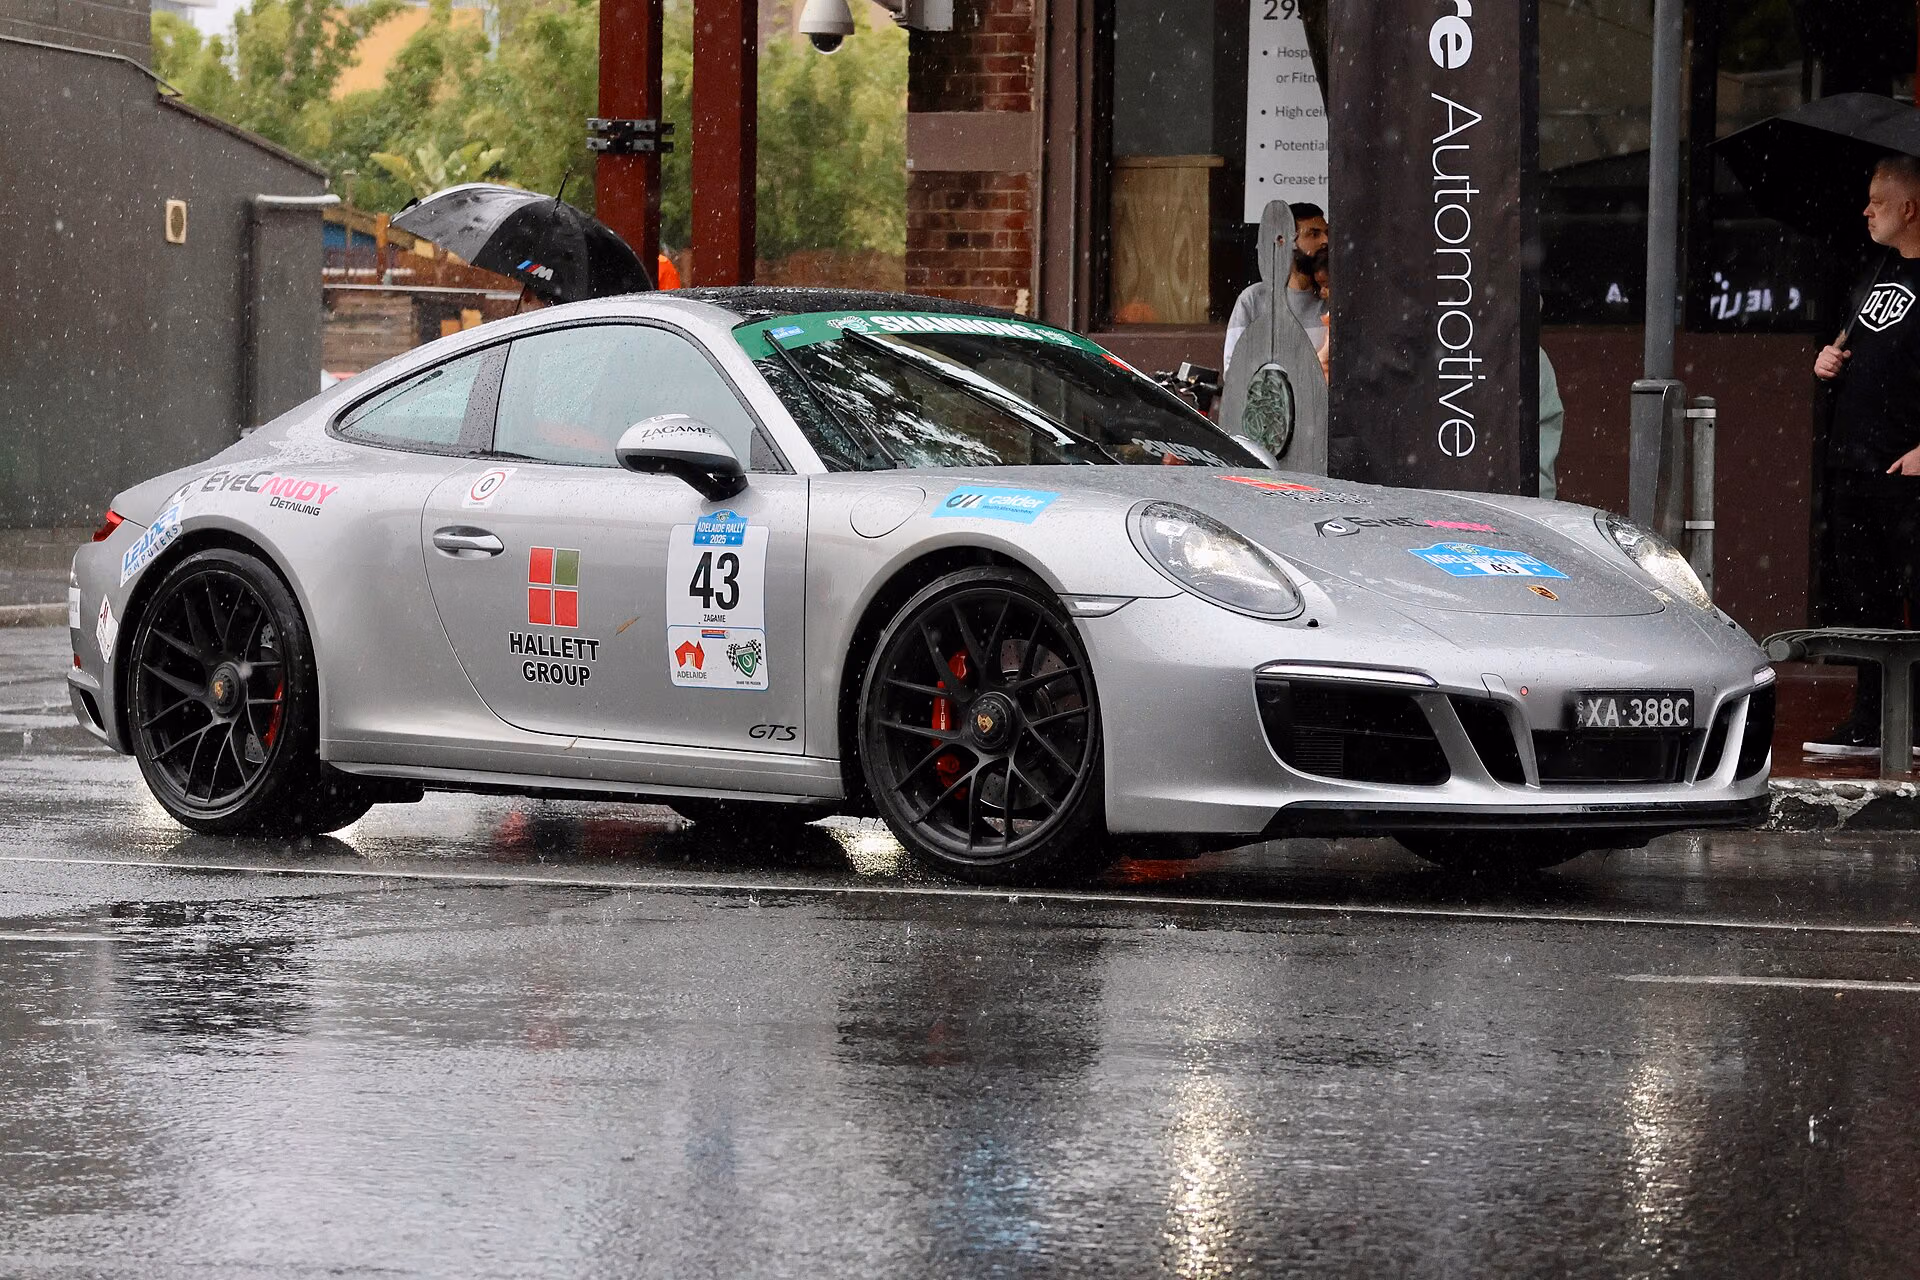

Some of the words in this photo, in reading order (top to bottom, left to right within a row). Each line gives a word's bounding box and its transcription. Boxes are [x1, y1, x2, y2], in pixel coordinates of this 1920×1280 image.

[1263, 0, 1302, 20] 29
[1276, 74, 1289, 83] or
[1292, 72, 1318, 83] Fitn
[1275, 106, 1303, 119] High
[1275, 140, 1328, 151] Potential
[1273, 173, 1315, 185] Grease
[1431, 93, 1486, 457] Automotive
[1861, 290, 1908, 324] DEUS
[870, 316, 1043, 341] SHANNONS
[642, 426, 712, 438] ZAGAME
[697, 522, 726, 533] ADELAIDE
[726, 523, 745, 533] RALLY
[710, 535, 727, 544] 2025
[1489, 563, 1520, 574] 43
[689, 551, 740, 611] 43
[508, 632, 600, 662] HALLETT
[522, 660, 591, 687] GROUP
[677, 671, 708, 680] ADELAIDE
[748, 724, 798, 741] GTS
